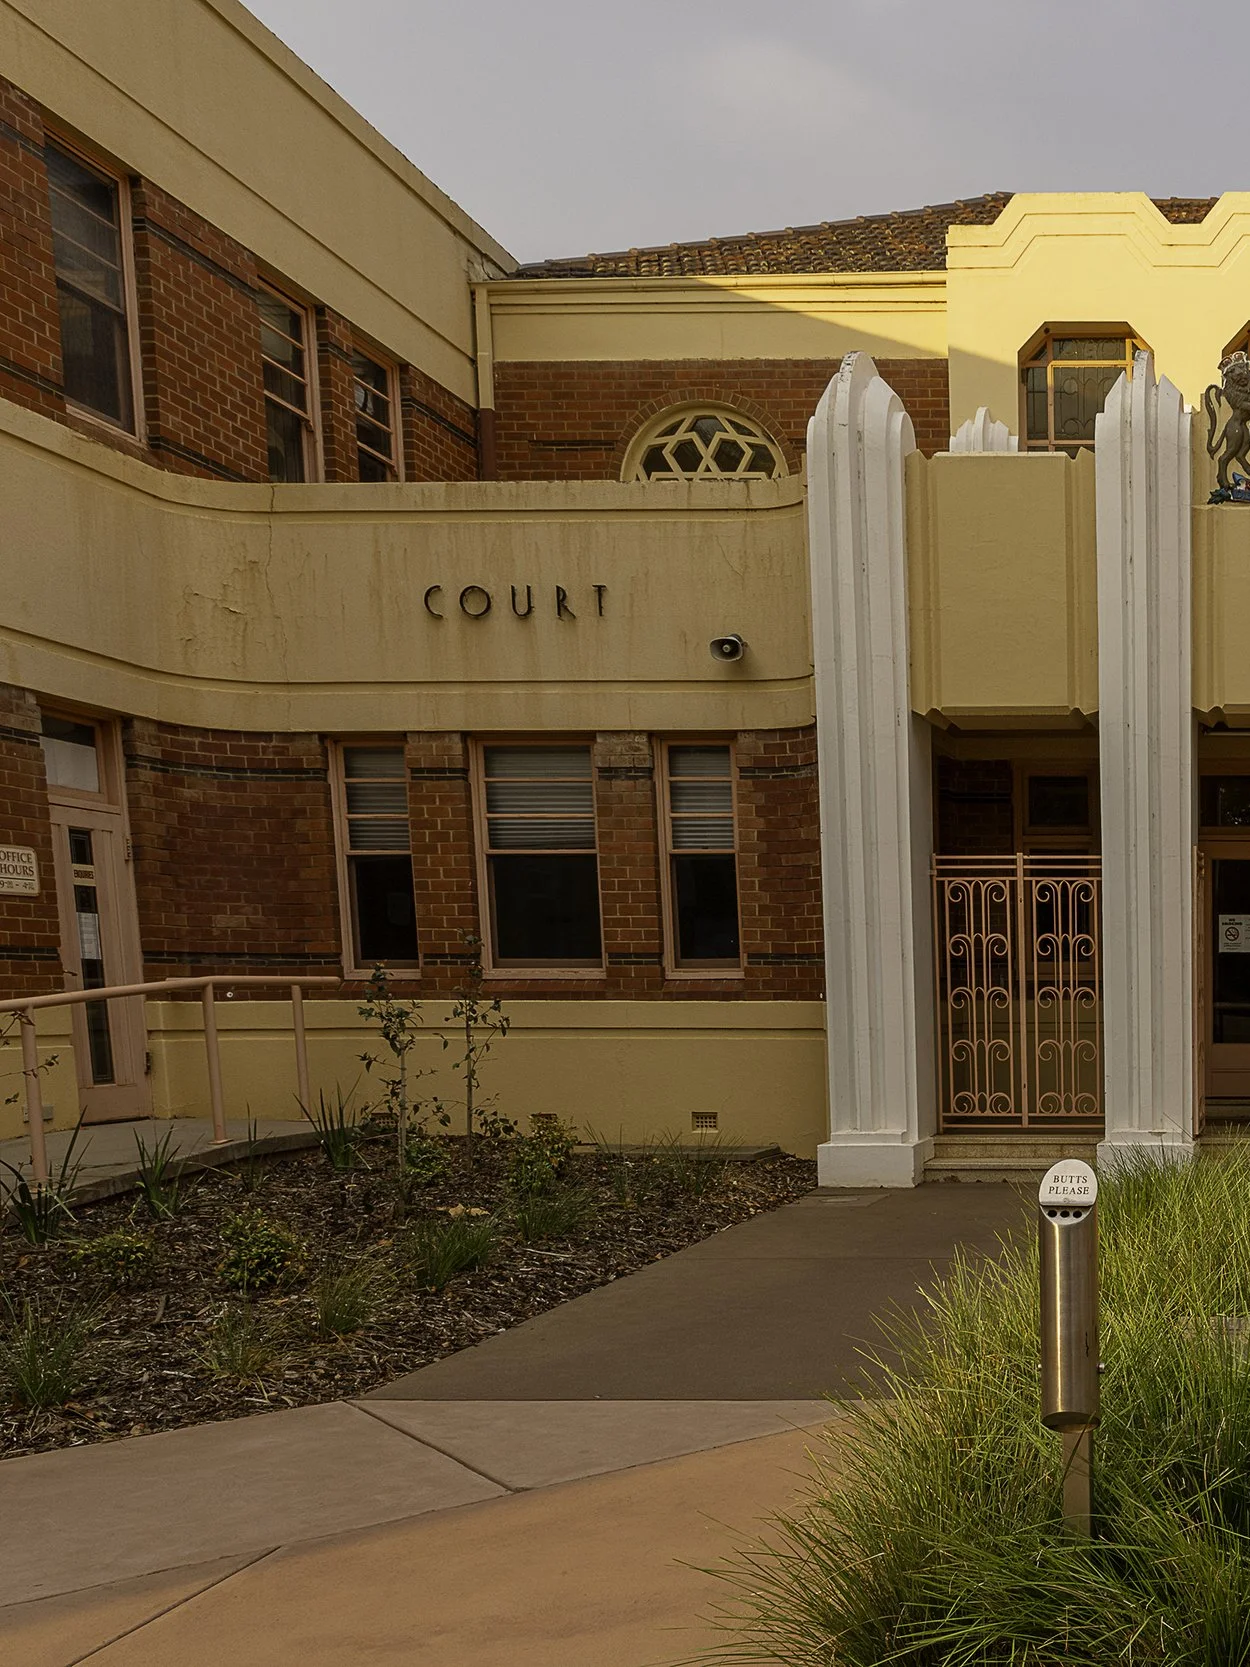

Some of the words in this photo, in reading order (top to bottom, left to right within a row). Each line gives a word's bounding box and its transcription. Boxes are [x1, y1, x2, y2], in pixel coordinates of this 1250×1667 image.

[424, 584, 607, 619] COURT
[0, 850, 33, 864] OFFICE
[0, 863, 35, 876] HOURS
[1053, 1174, 1088, 1184] BUTTS
[1048, 1186, 1090, 1195] PLEASE
